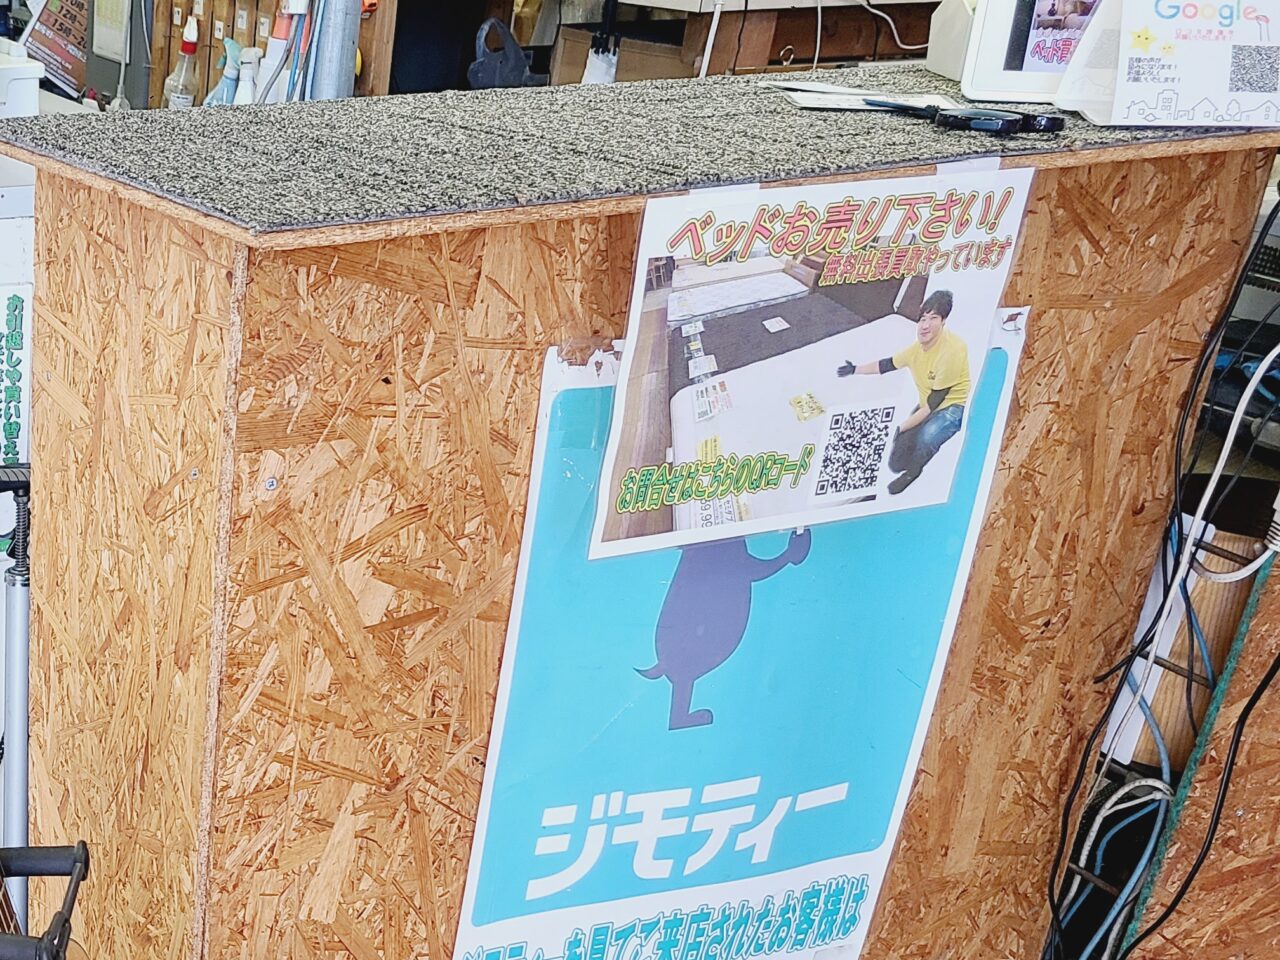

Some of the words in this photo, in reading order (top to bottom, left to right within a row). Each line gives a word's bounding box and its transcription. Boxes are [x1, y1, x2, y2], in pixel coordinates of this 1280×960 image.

[1154, 0, 1259, 27] Google
[667, 187, 1014, 266] ベッドお売り下さい!
[818, 236, 1012, 286] 無料出張買取やっています
[617, 444, 815, 513] お問合せはこちらのQRコード
[525, 776, 849, 900] ジモティー
